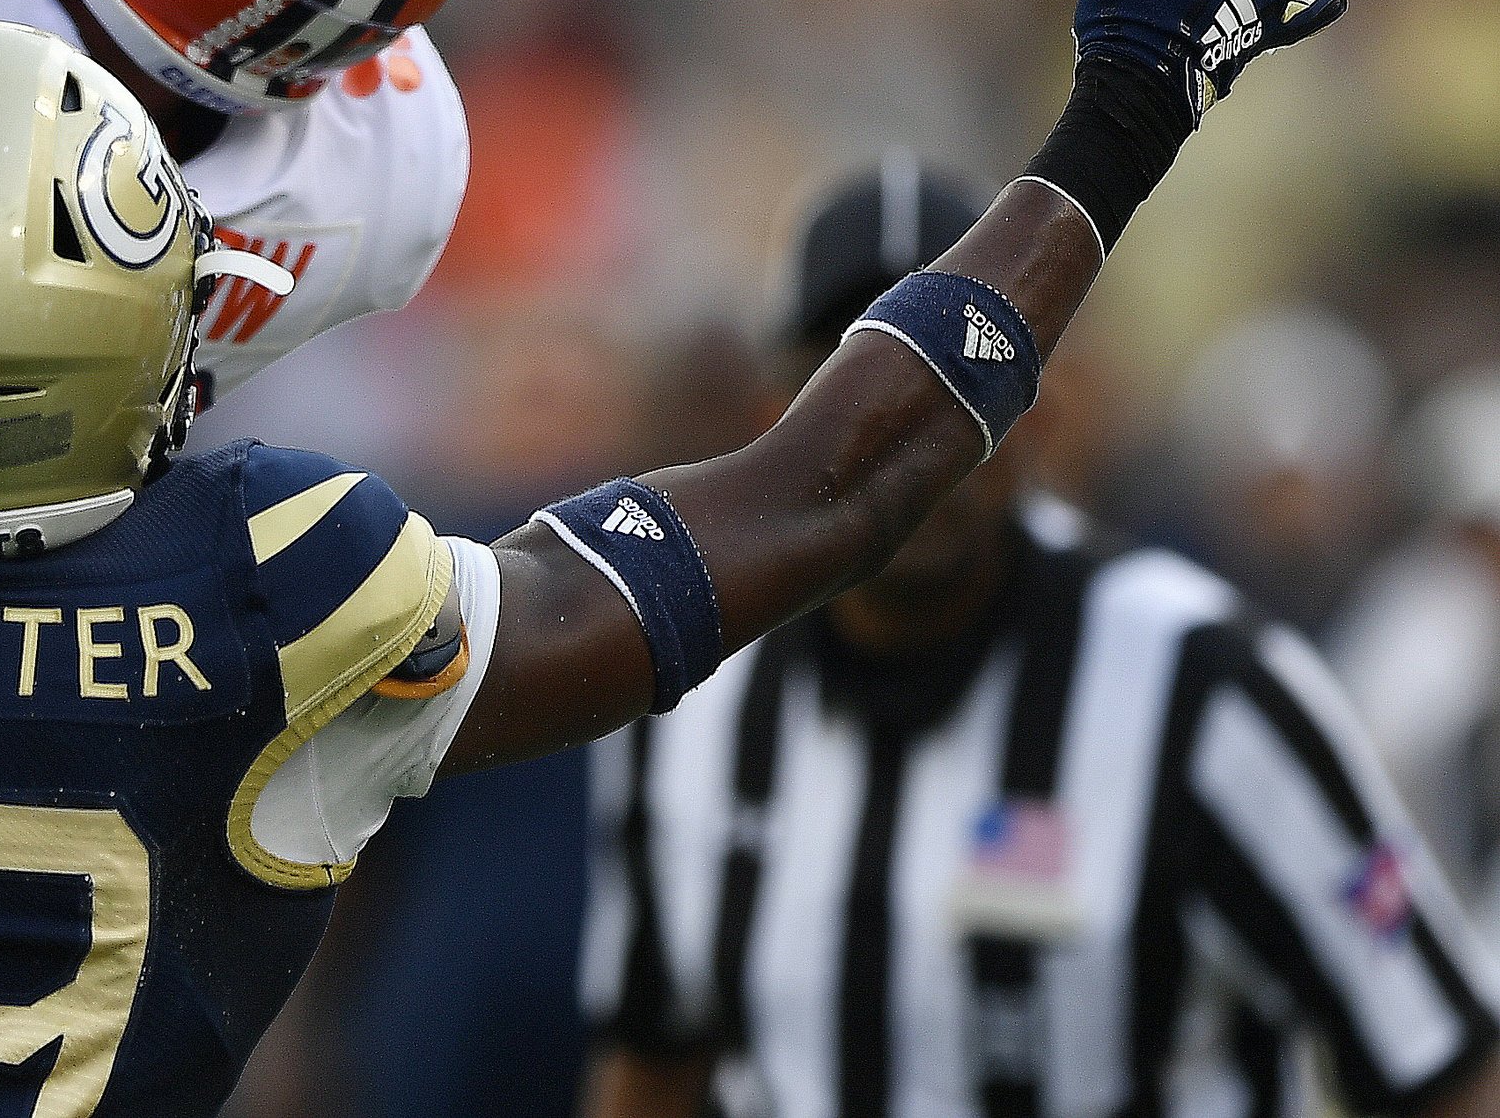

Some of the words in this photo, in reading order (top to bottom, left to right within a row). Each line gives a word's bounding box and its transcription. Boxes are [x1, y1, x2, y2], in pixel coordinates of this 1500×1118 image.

[1201, 20, 1263, 72] adidas
[963, 303, 1016, 361] adidas
[617, 496, 665, 541] adidas
